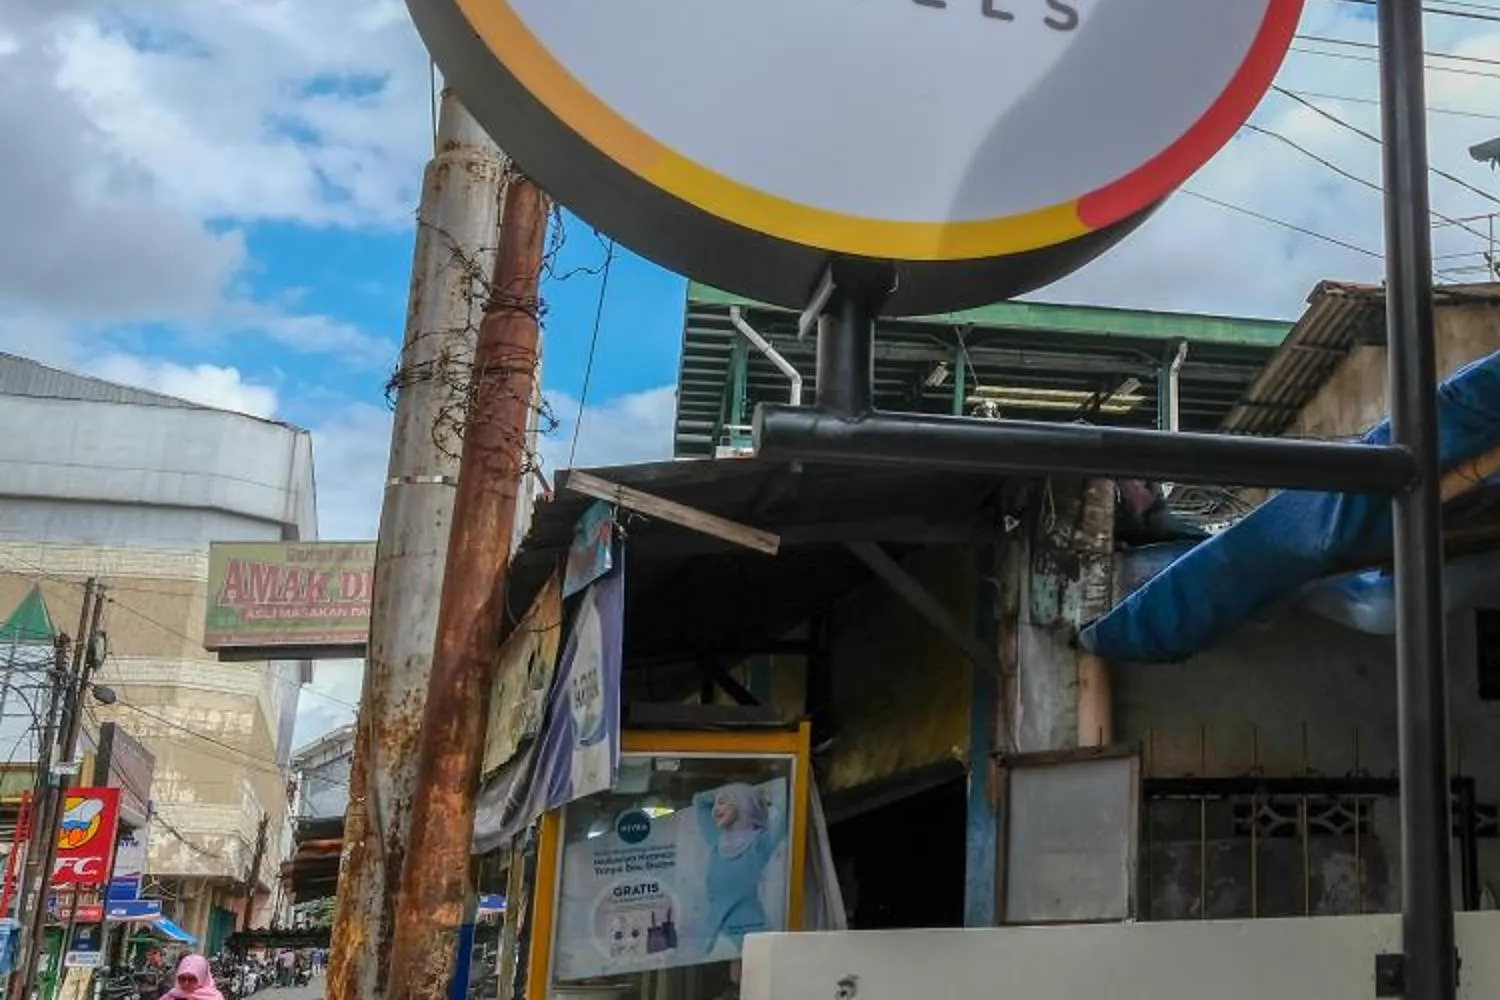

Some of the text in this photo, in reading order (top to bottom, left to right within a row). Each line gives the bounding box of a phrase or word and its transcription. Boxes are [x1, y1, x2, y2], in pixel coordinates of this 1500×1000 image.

[218, 558, 330, 604] AMAK
[351, 606, 372, 618] PA
[52, 856, 103, 877] FC
[613, 882, 660, 897] GRATIS
